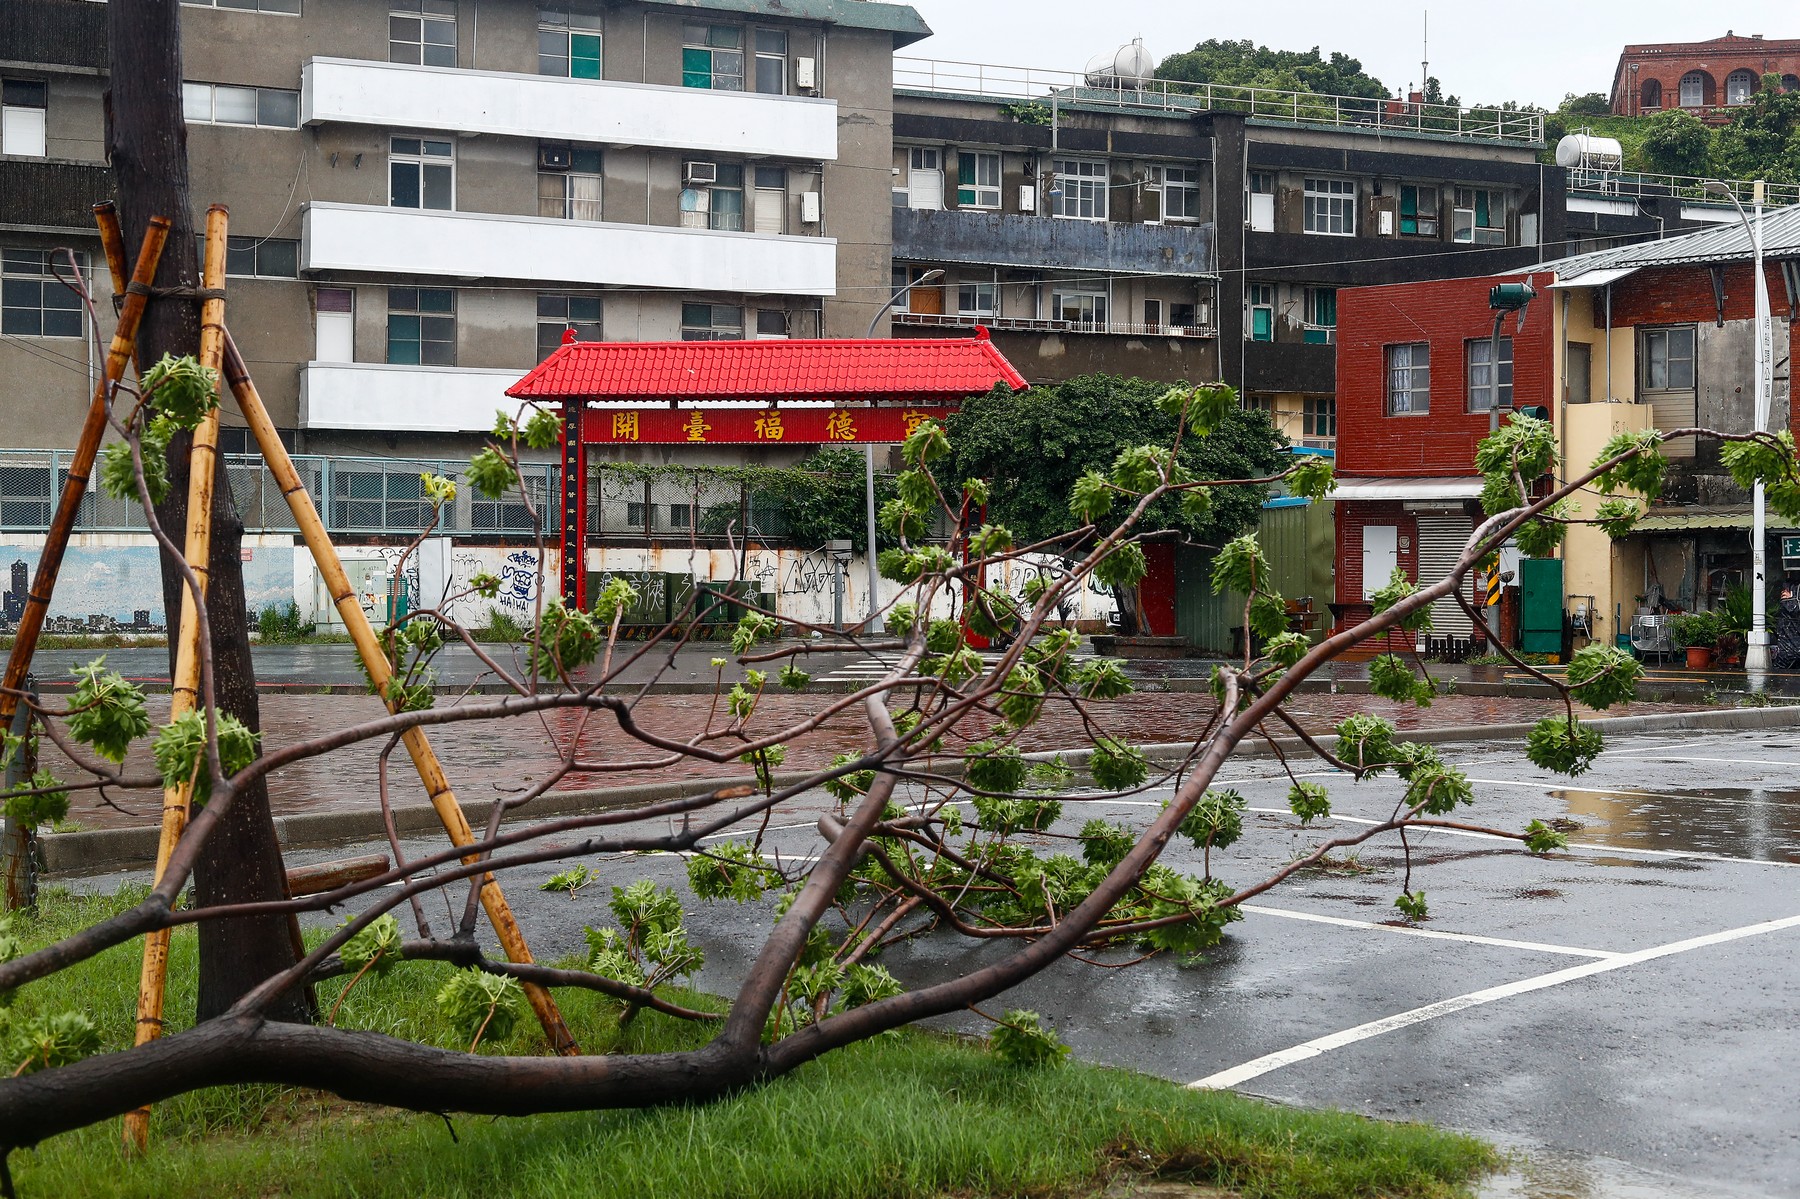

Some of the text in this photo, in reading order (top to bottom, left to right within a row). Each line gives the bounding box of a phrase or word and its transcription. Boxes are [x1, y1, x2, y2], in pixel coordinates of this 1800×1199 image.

[612, 410, 930, 442] 開臺福德宮
